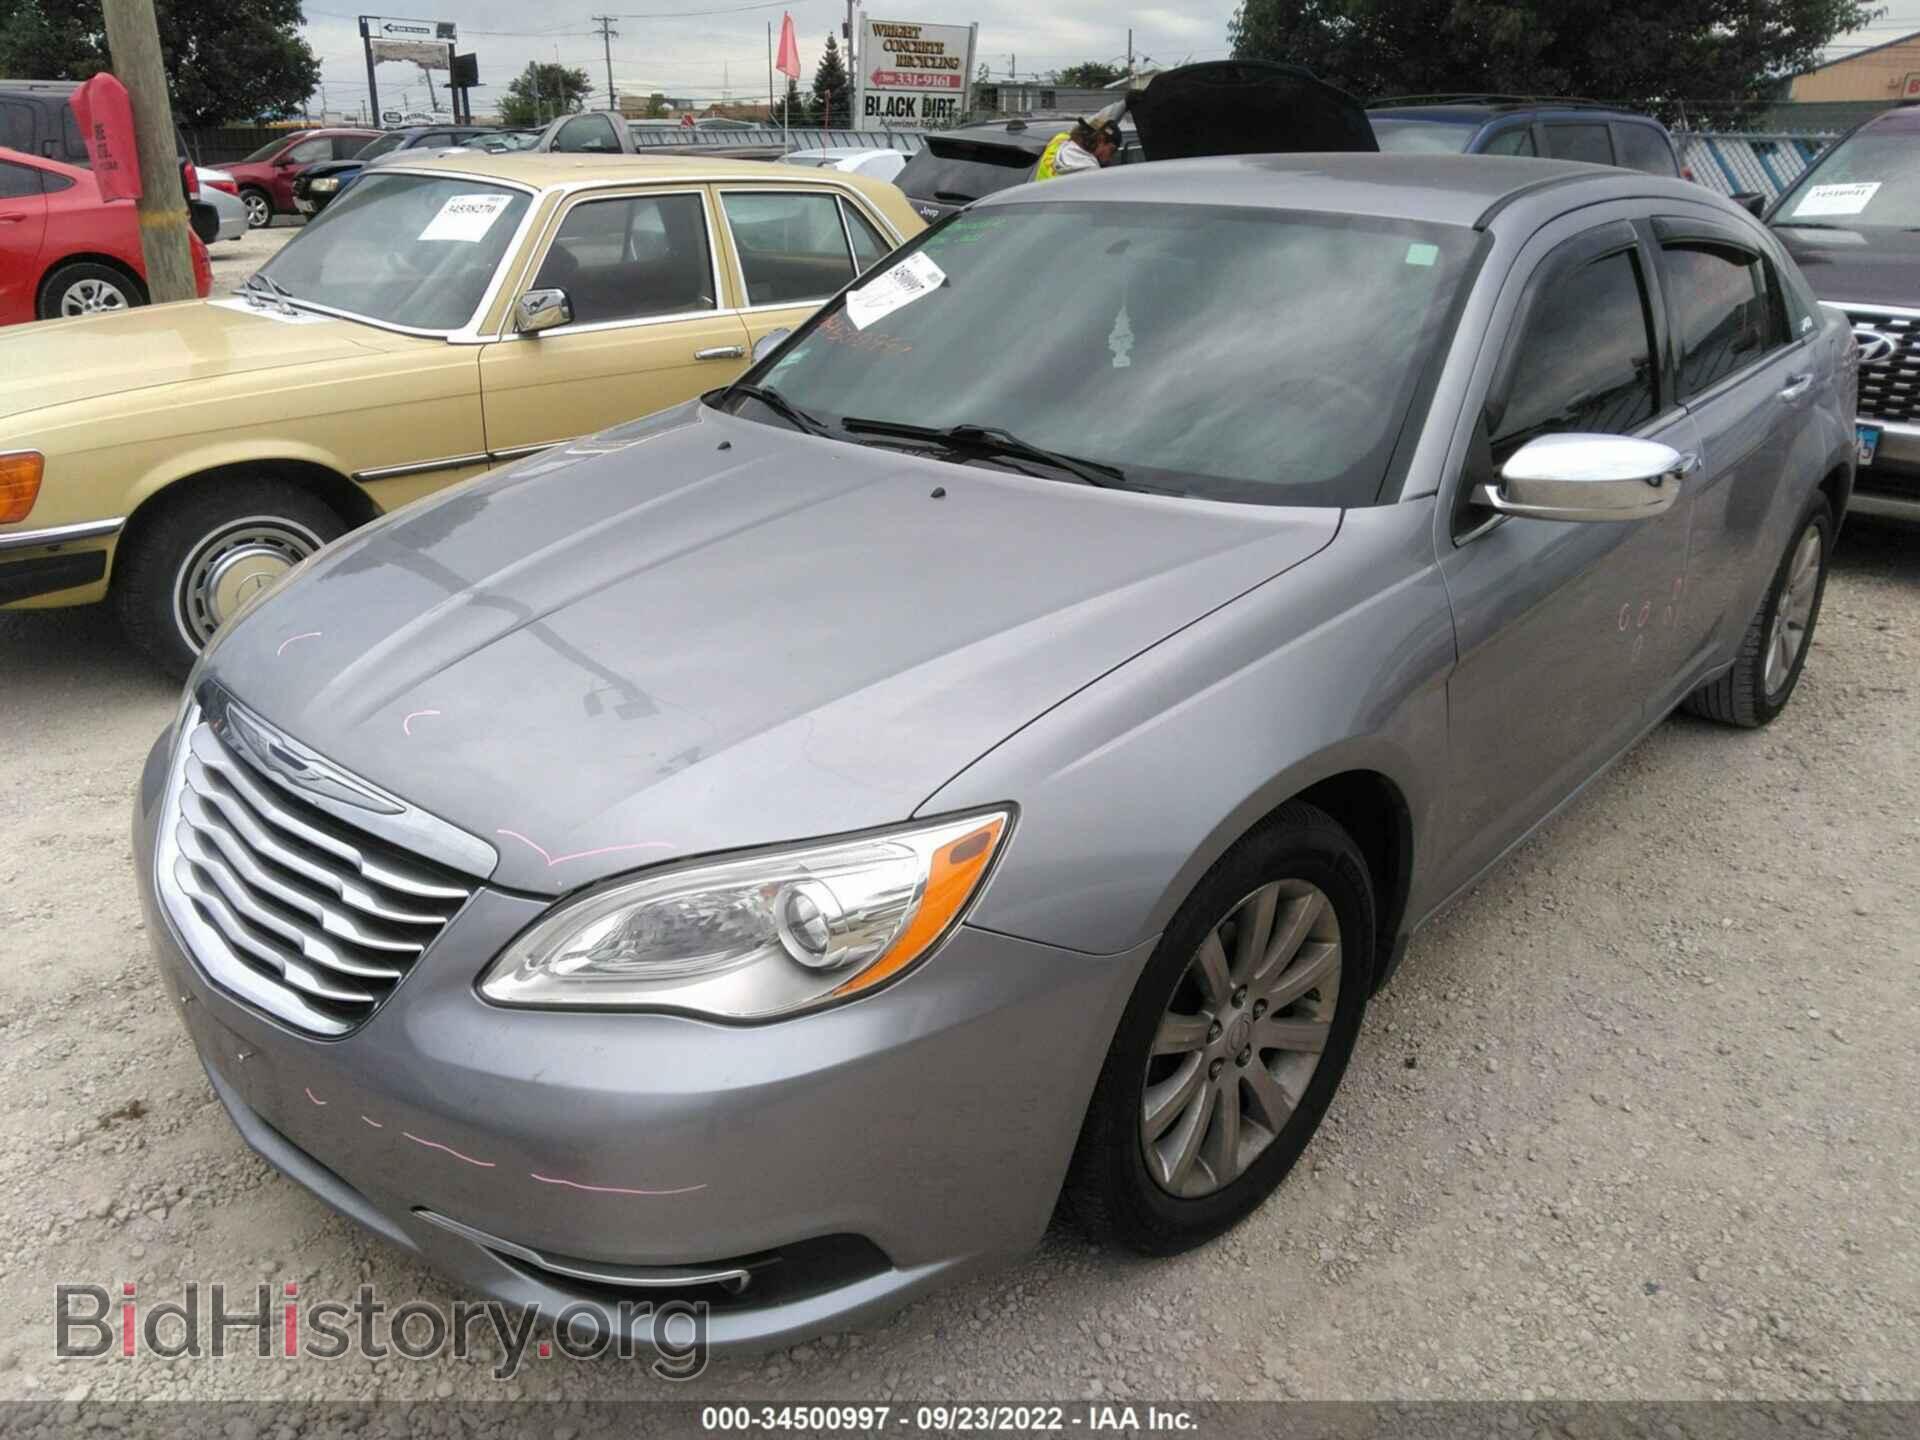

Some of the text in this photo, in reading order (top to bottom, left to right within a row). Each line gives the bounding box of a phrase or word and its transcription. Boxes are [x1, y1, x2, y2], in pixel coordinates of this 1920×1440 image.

[883, 39, 944, 55] CONCRETE
[895, 54, 960, 70] RECYCLING
[865, 95, 956, 120] BLACK DIRT
